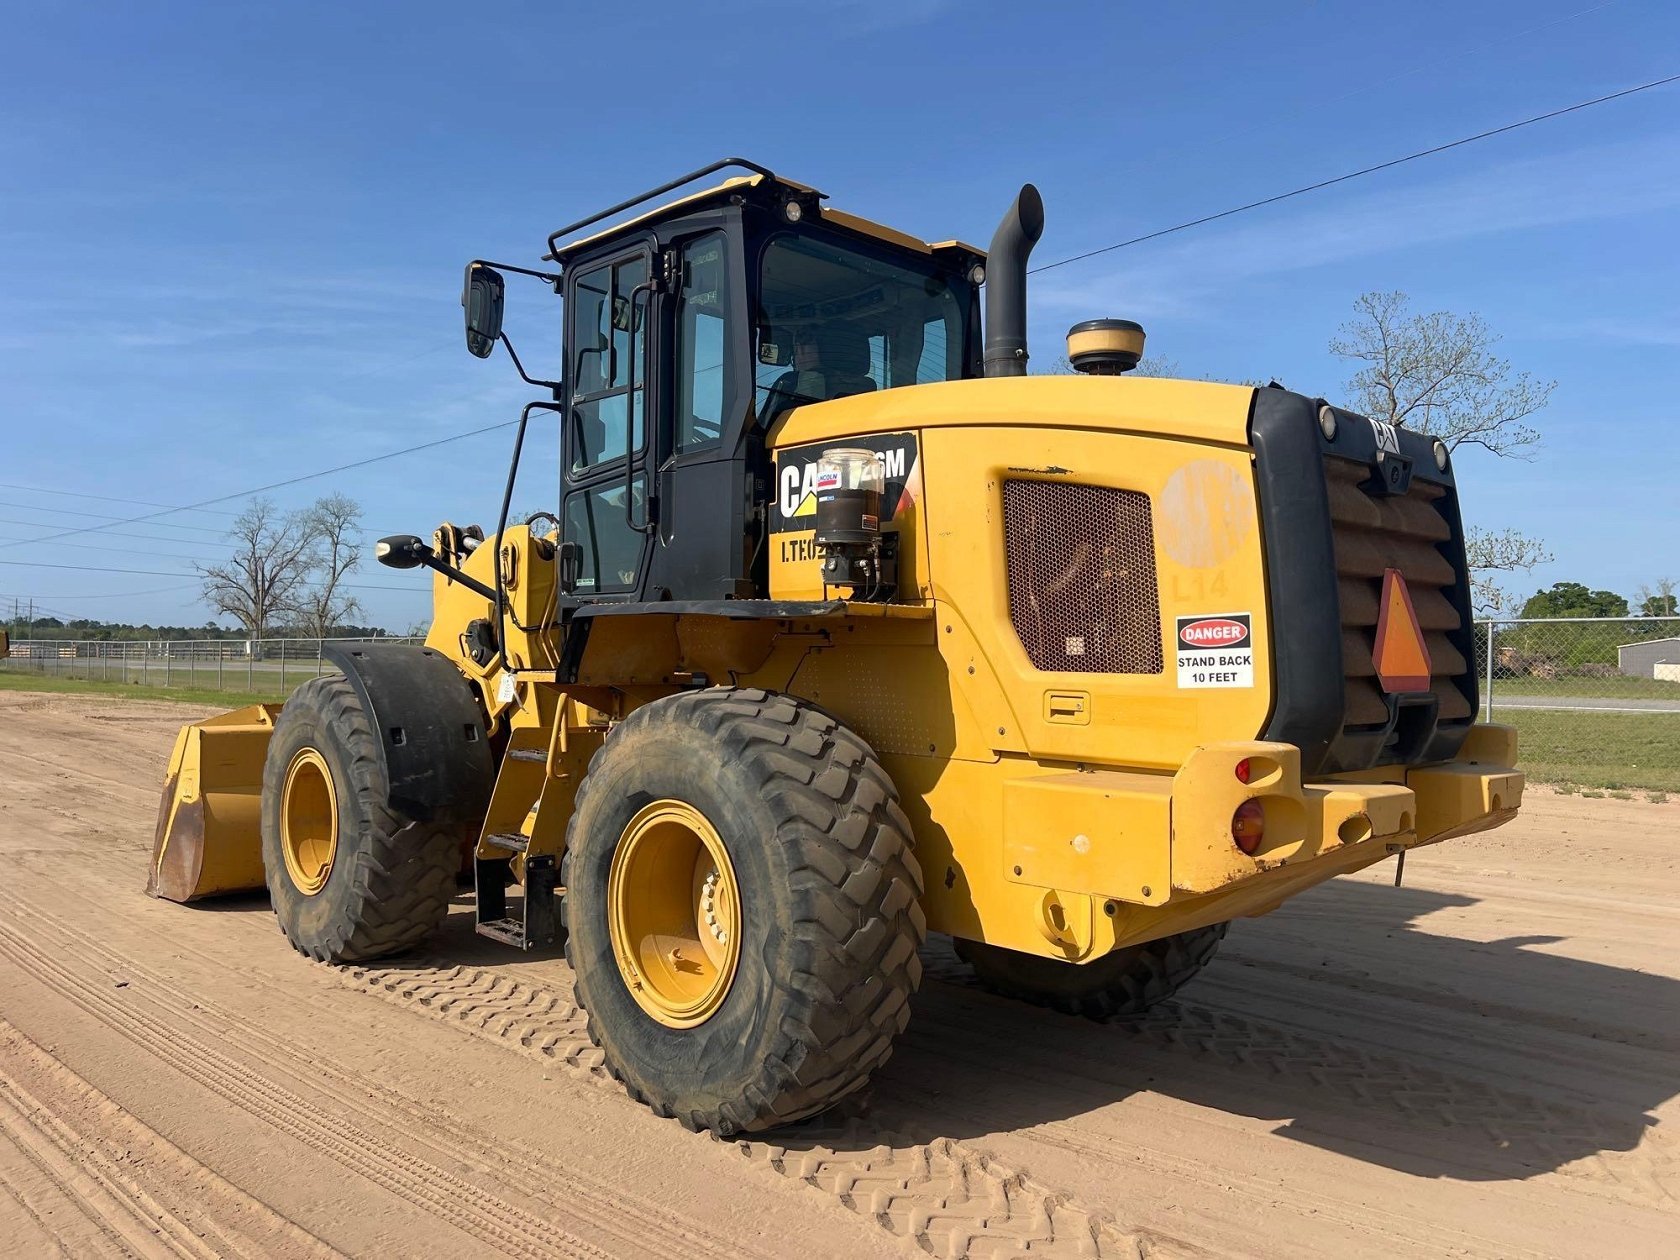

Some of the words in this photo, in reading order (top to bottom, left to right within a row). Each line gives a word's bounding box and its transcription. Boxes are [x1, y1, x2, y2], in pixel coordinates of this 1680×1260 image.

[1368, 418, 1400, 454] CAT
[780, 462, 818, 518] CA
[1185, 626, 1241, 640] DANGER
[1178, 656, 1215, 667] STAND
[1219, 655, 1251, 666] BACK
[1192, 673, 1205, 682] 10
[1209, 672, 1237, 682] FEET
